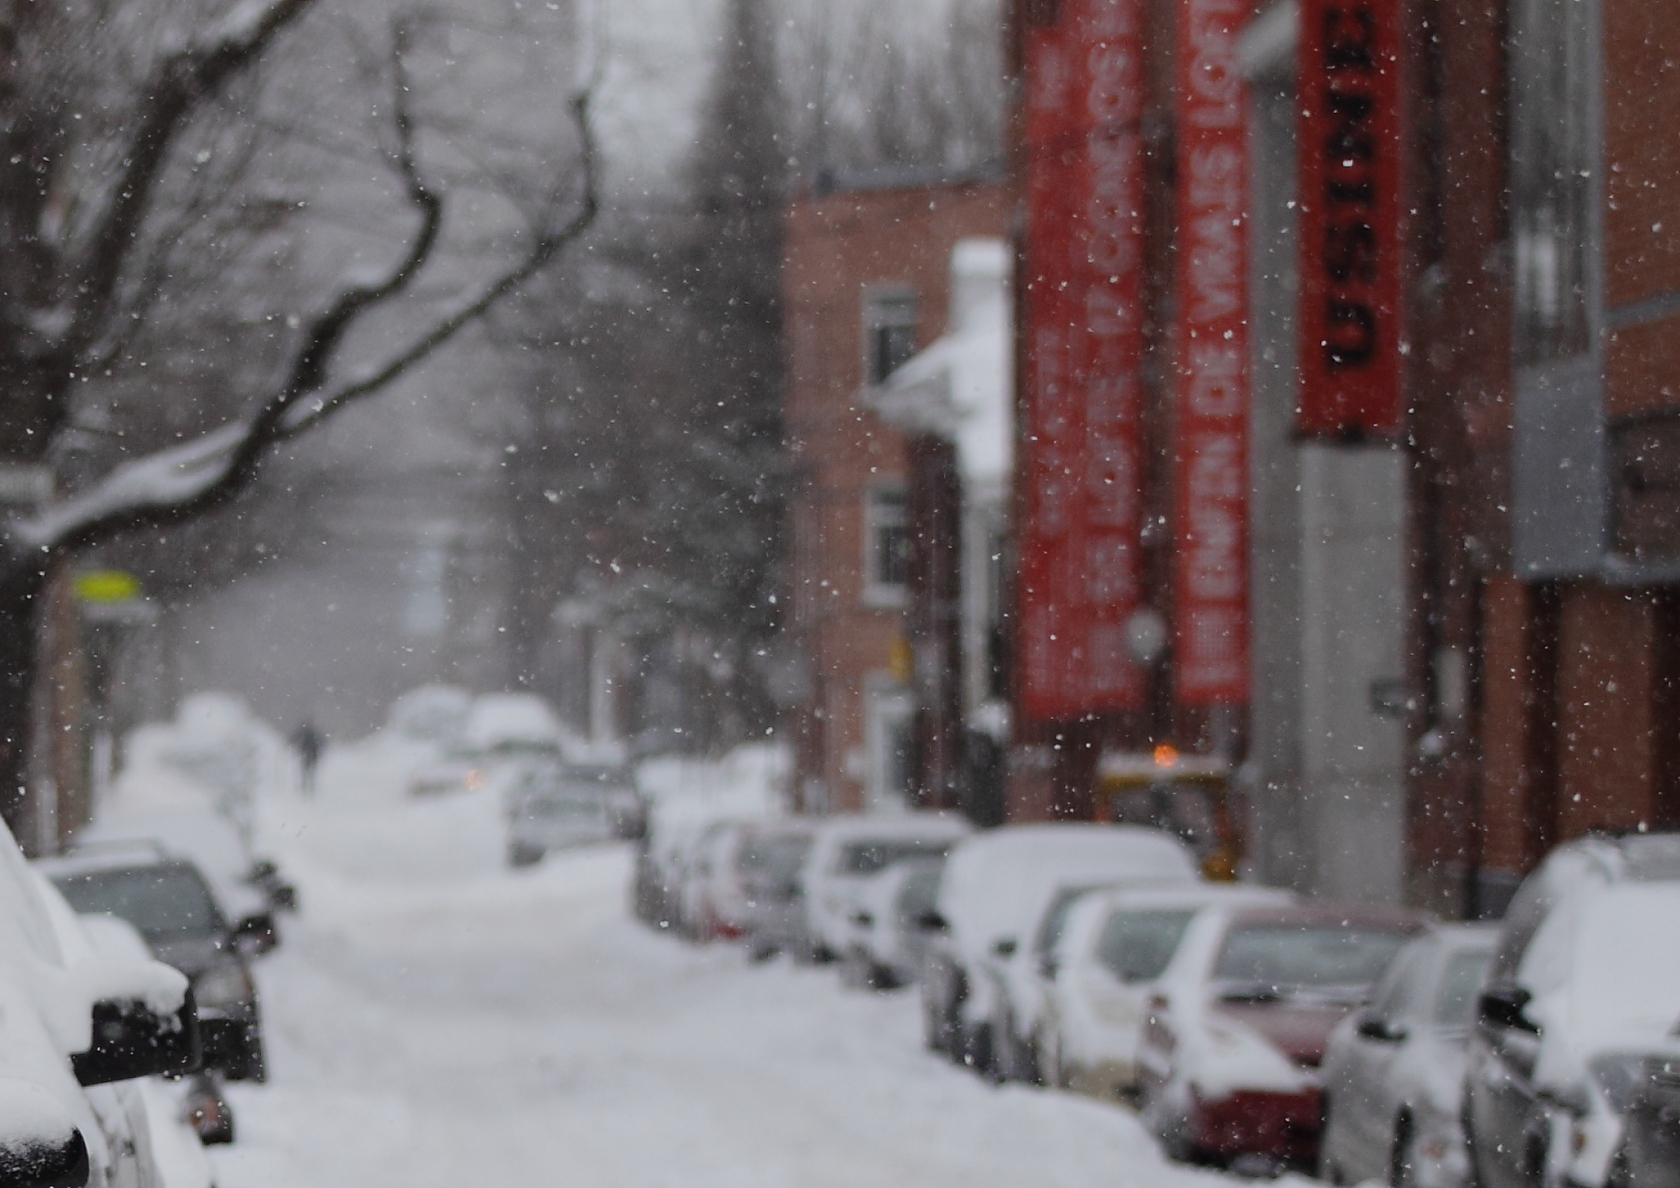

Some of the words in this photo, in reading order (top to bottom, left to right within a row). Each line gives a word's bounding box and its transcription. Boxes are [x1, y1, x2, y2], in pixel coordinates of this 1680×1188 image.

[1086, 43, 1135, 275] CONDOS
[1188, 146, 1240, 324] VRAIS
[1323, 5, 1376, 371] USINE
[1188, 340, 1240, 417] DE
[1188, 434, 1240, 599] ENFIN
